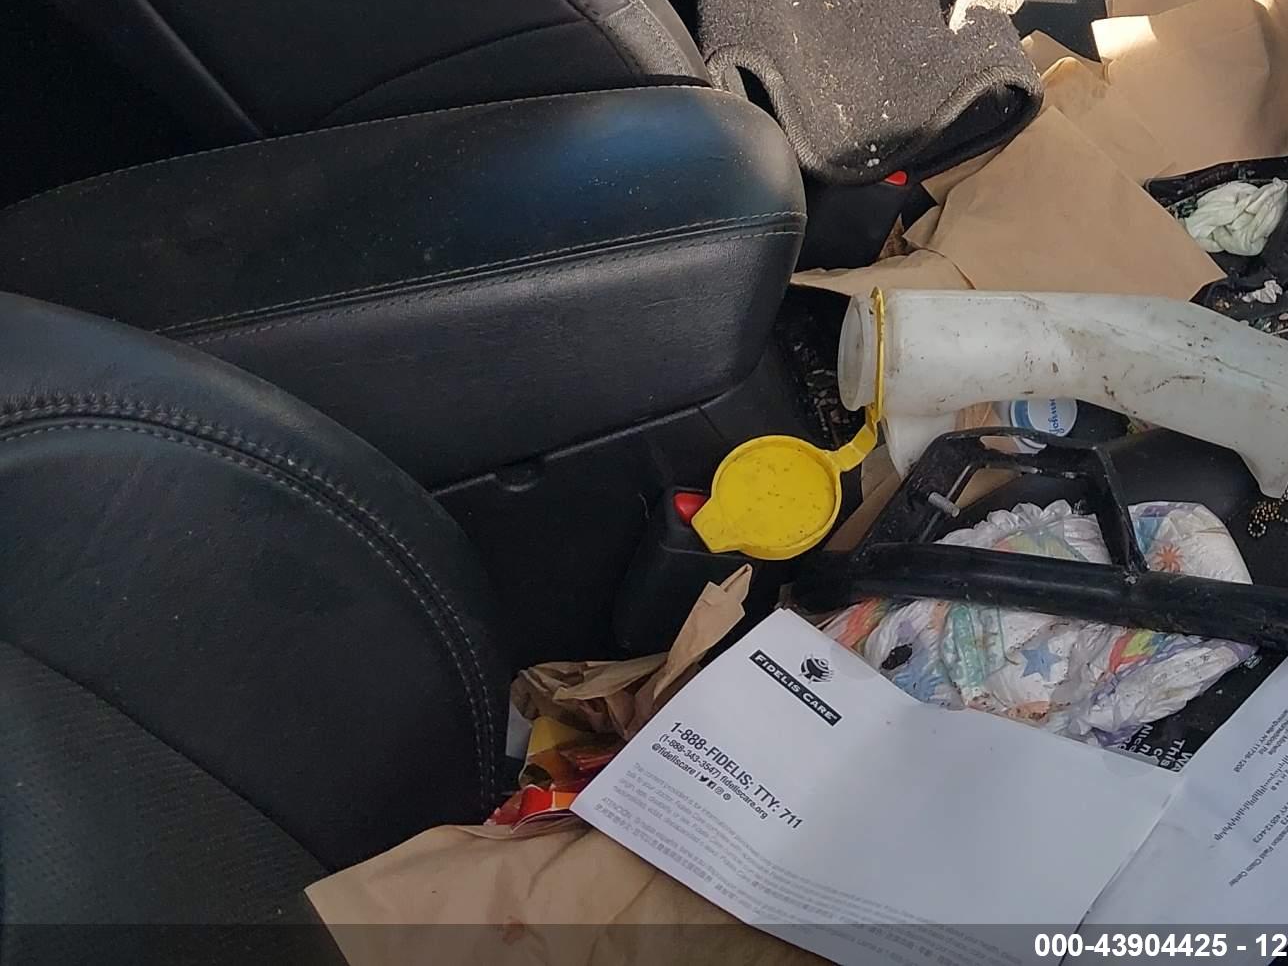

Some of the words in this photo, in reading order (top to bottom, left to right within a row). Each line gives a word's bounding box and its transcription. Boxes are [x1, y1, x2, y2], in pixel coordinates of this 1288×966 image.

[754, 652, 801, 693] FIDELIS
[801, 691, 837, 720] CARE
[650, 741, 696, 776] @fideliscare
[658, 731, 721, 779] (1-888-343-3547)
[719, 774, 768, 819] fideliscare.org
[669, 719, 755, 789] 1-888-FIDELIS;
[753, 784, 781, 813] TTY:
[779, 807, 803, 828] 711
